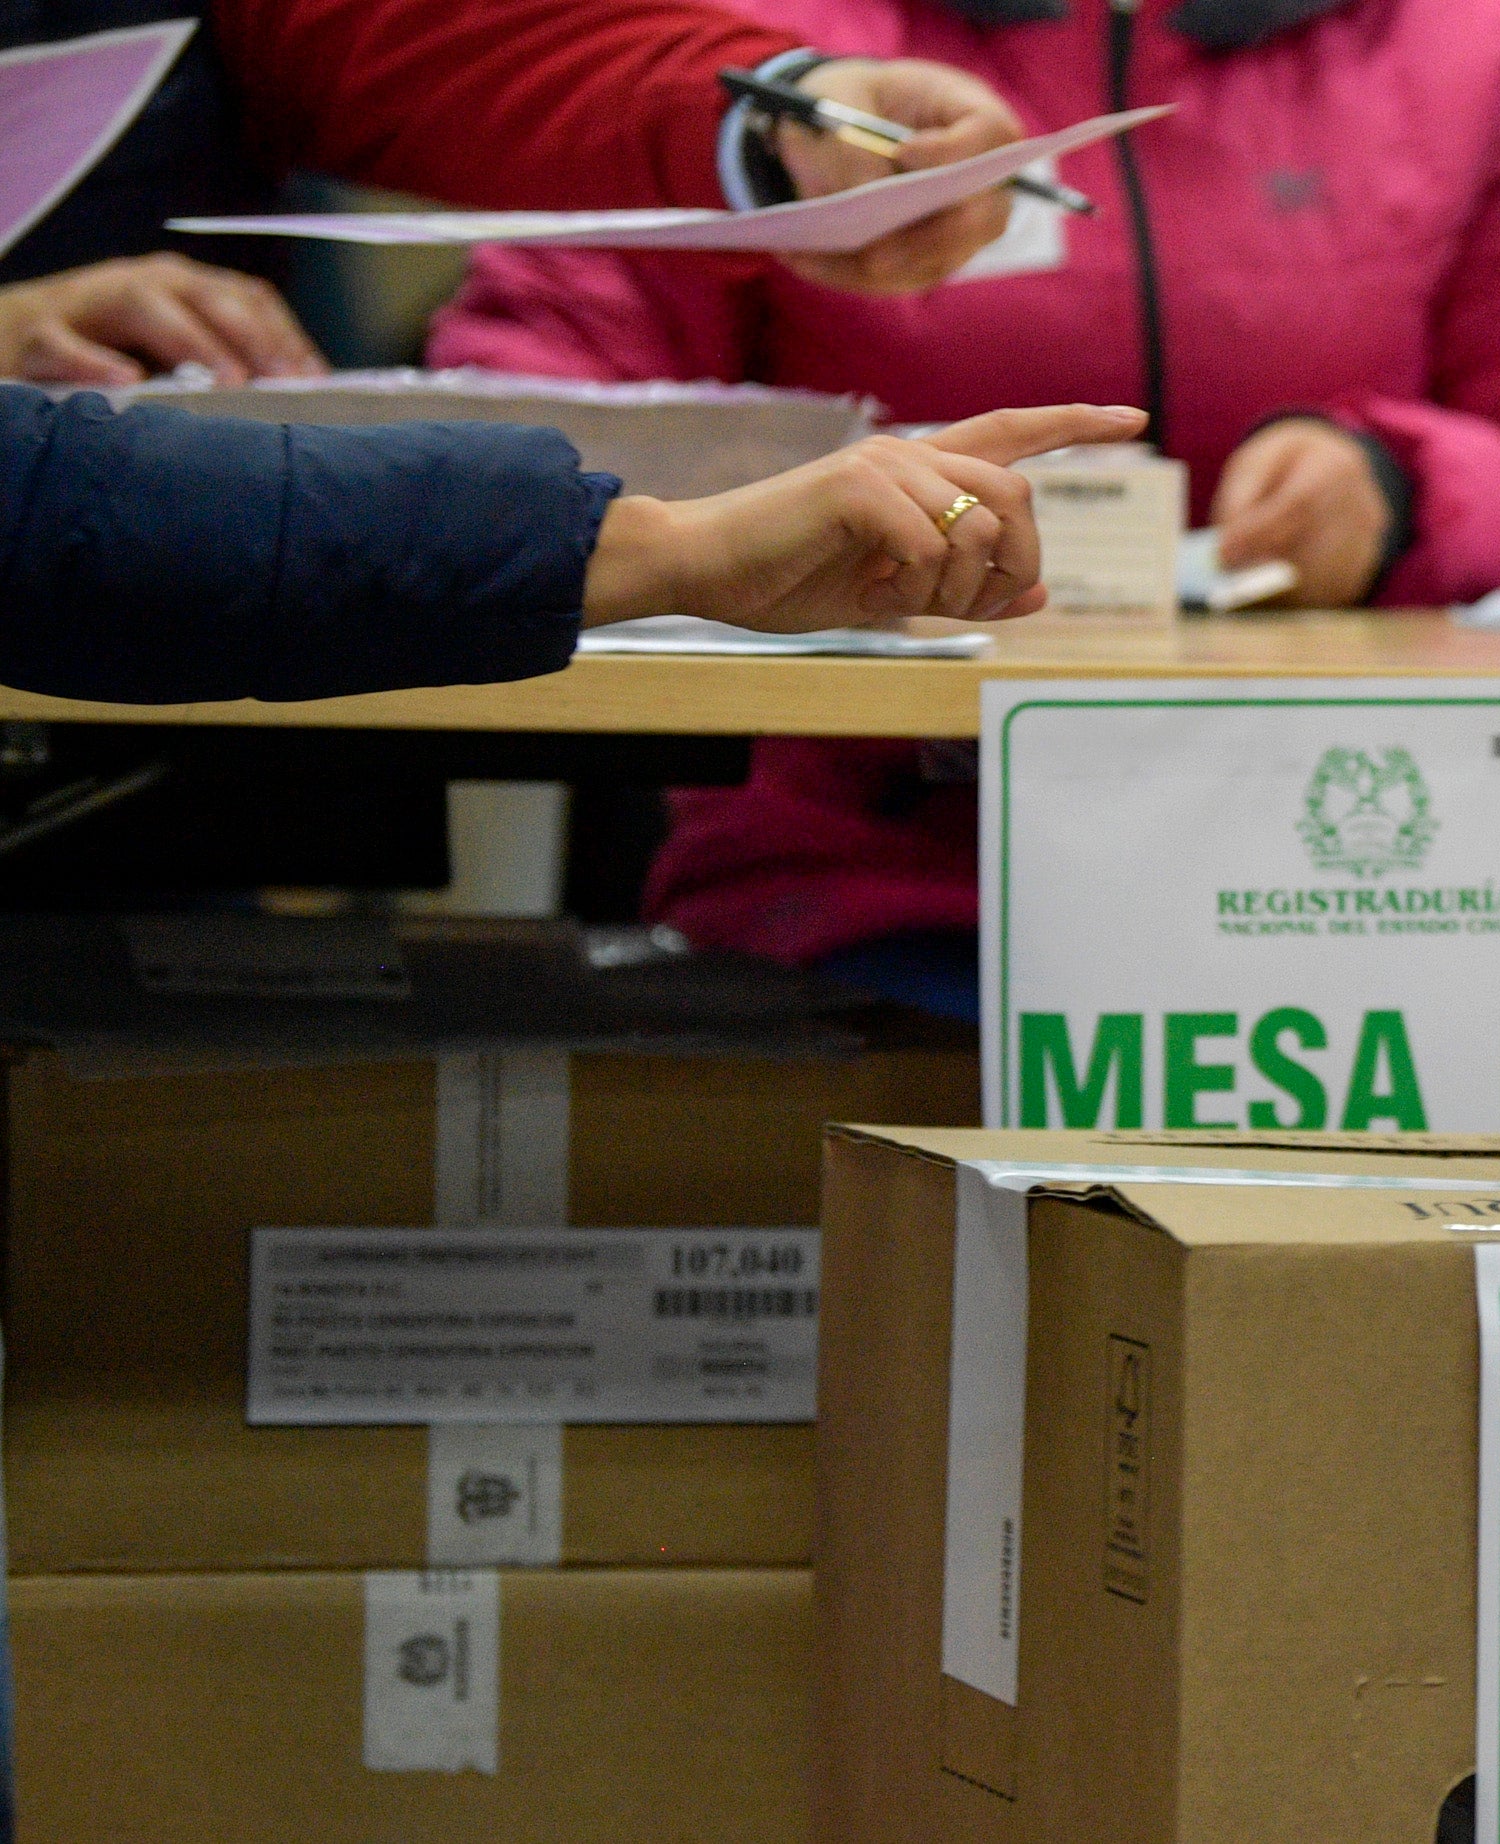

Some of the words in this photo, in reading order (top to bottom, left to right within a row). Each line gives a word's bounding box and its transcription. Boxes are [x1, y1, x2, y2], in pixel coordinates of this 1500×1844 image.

[1218, 919, 1319, 936] NACIONAL
[1328, 919, 1368, 936] DEL
[1377, 918, 1460, 935] ESTADO
[1018, 1005, 1431, 1132] MESA
